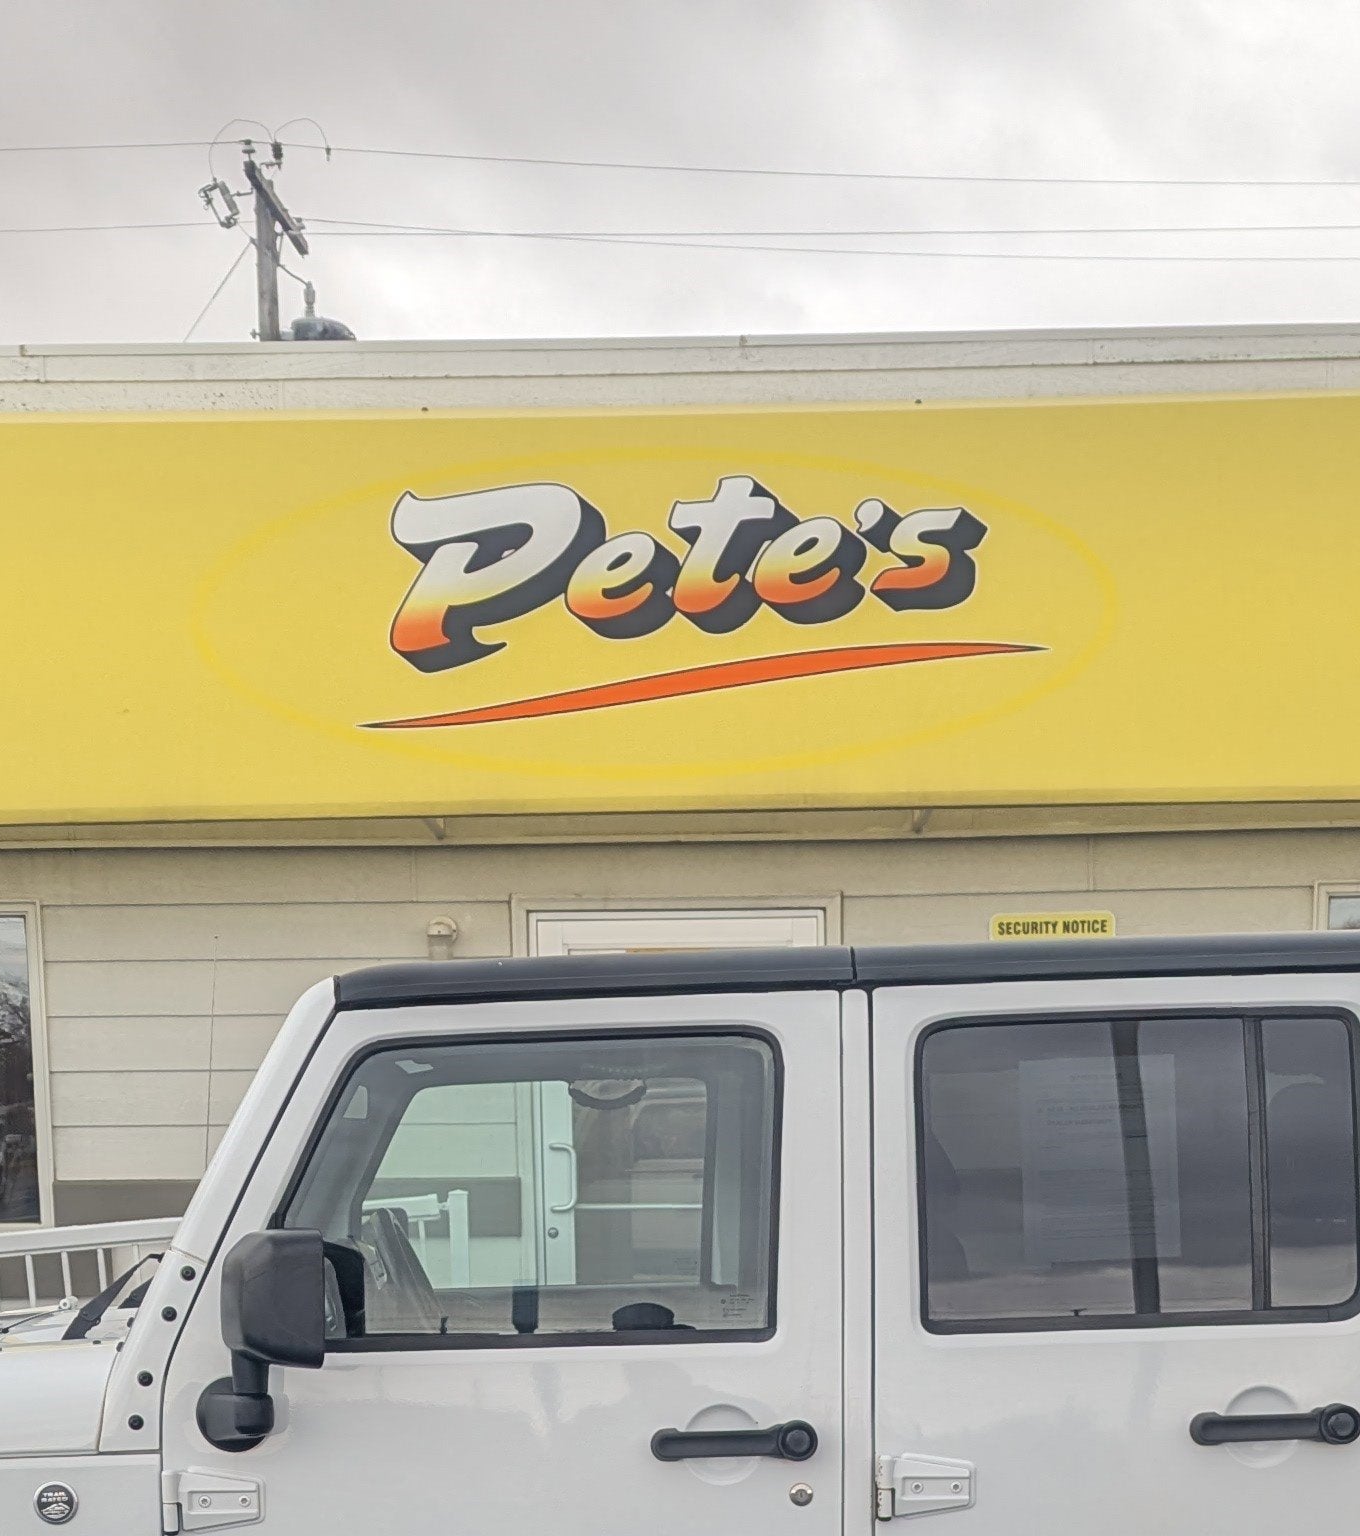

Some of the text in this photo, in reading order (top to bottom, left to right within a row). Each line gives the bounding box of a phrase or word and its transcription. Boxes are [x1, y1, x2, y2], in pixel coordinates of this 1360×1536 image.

[390, 475, 986, 674] Pete's
[997, 919, 1108, 936] SECURITY NOTICE
